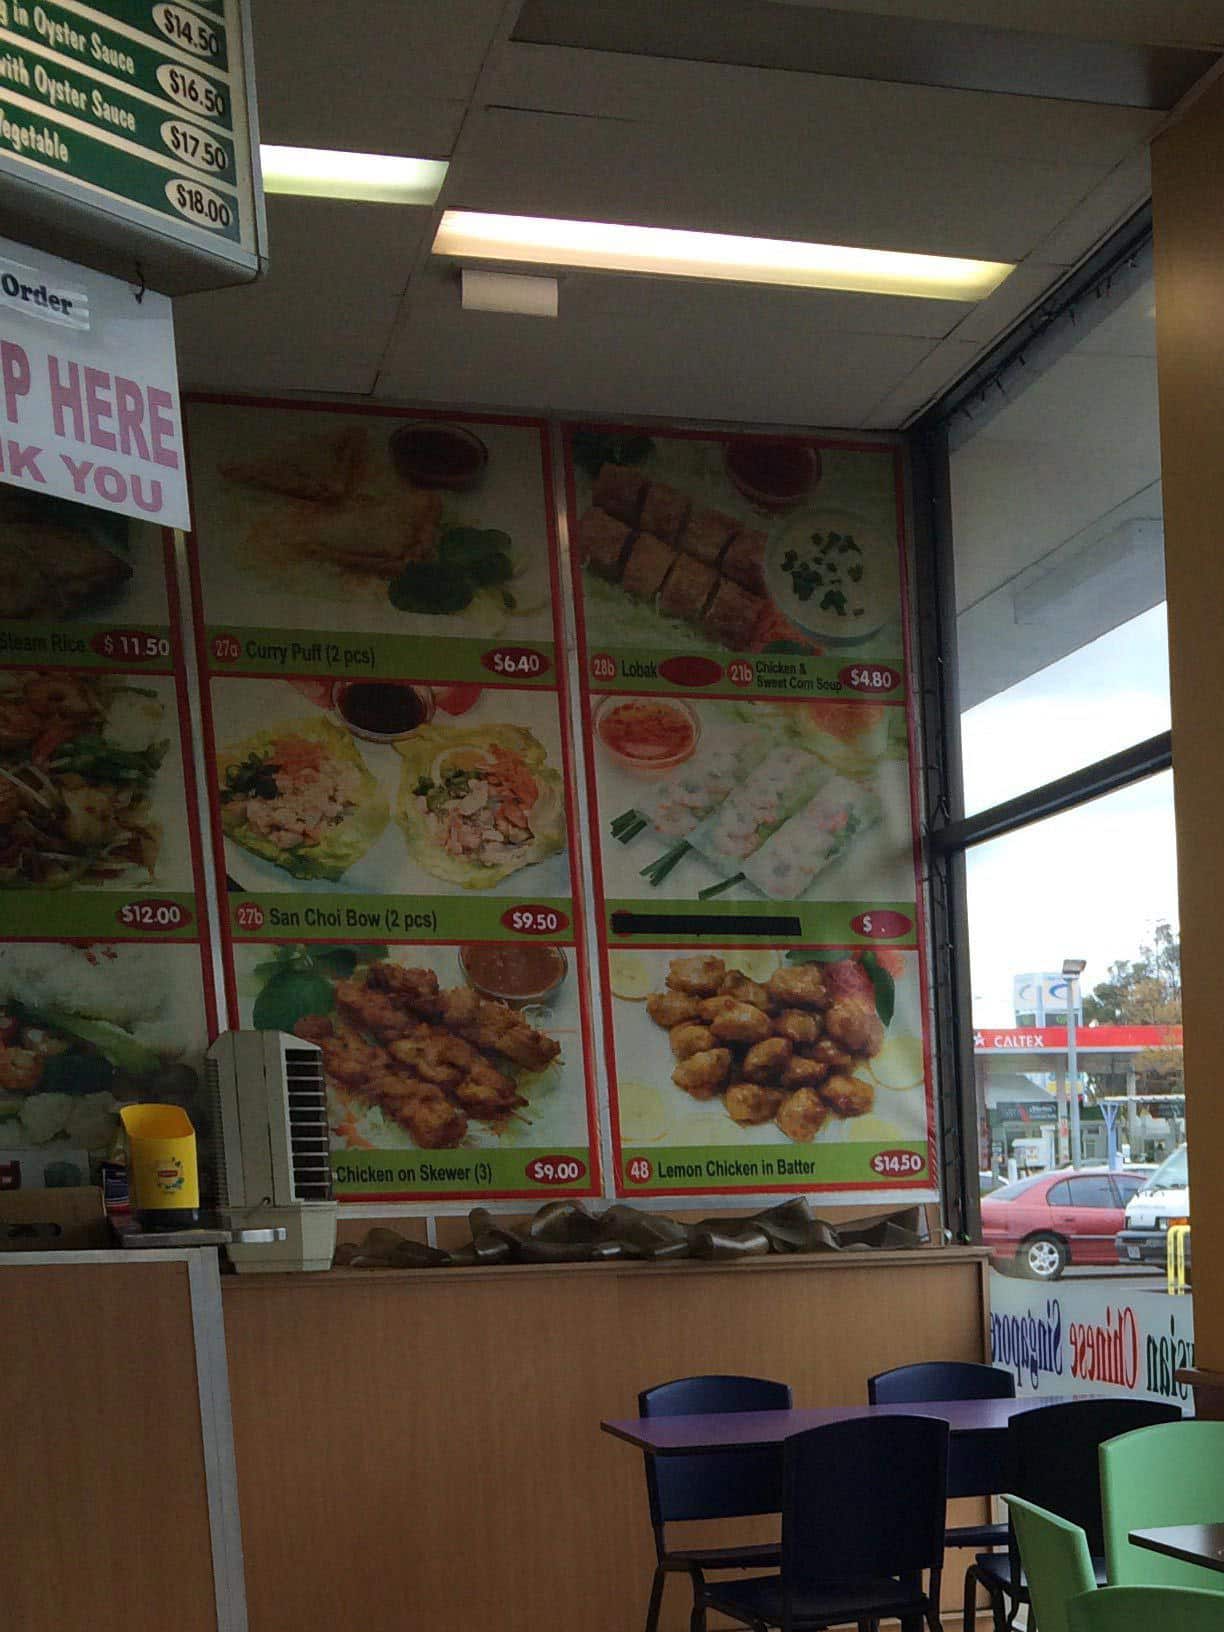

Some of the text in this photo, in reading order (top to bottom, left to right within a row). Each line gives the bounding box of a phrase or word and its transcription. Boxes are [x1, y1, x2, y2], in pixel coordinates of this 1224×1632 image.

[13, 0, 29, 28] in
[34, 6, 87, 52] Oyster
[91, 33, 136, 75] Sauce
[163, 8, 221, 55] $14.50
[34, 64, 87, 111] Oyster
[91, 90, 136, 132] Sauce
[169, 68, 226, 115] $16.50
[170, 126, 227, 171] $17.50
[176, 184, 231, 228] $18.00
[1, 273, 73, 316] Order
[48, 354, 179, 470] HERE
[59, 454, 163, 513] YOU
[52, 633, 86, 652] Rice
[246, 640, 287, 665] Curry
[291, 642, 322, 662] Puff
[494, 653, 541, 673] $6.40
[621, 660, 658, 679] Lobak
[756, 660, 795, 674] Chicken
[757, 675, 787, 689] Sweet
[817, 677, 843, 694] Soup
[850, 668, 893, 689] $4.80
[121, 905, 181, 925] $12.00
[238, 908, 264, 925] 27b
[270, 908, 299, 927] San
[307, 908, 341, 928] Choi
[347, 909, 380, 928] Bow
[512, 911, 557, 930] $9.50
[994, 1034, 1044, 1048] CALTEX
[534, 1163, 579, 1179] $9.00
[630, 1159, 816, 1178] 48 Lemon Chicken in Batter
[873, 1154, 922, 1171] $14.50
[336, 1163, 492, 1184] Chicken on Skewer (3)
